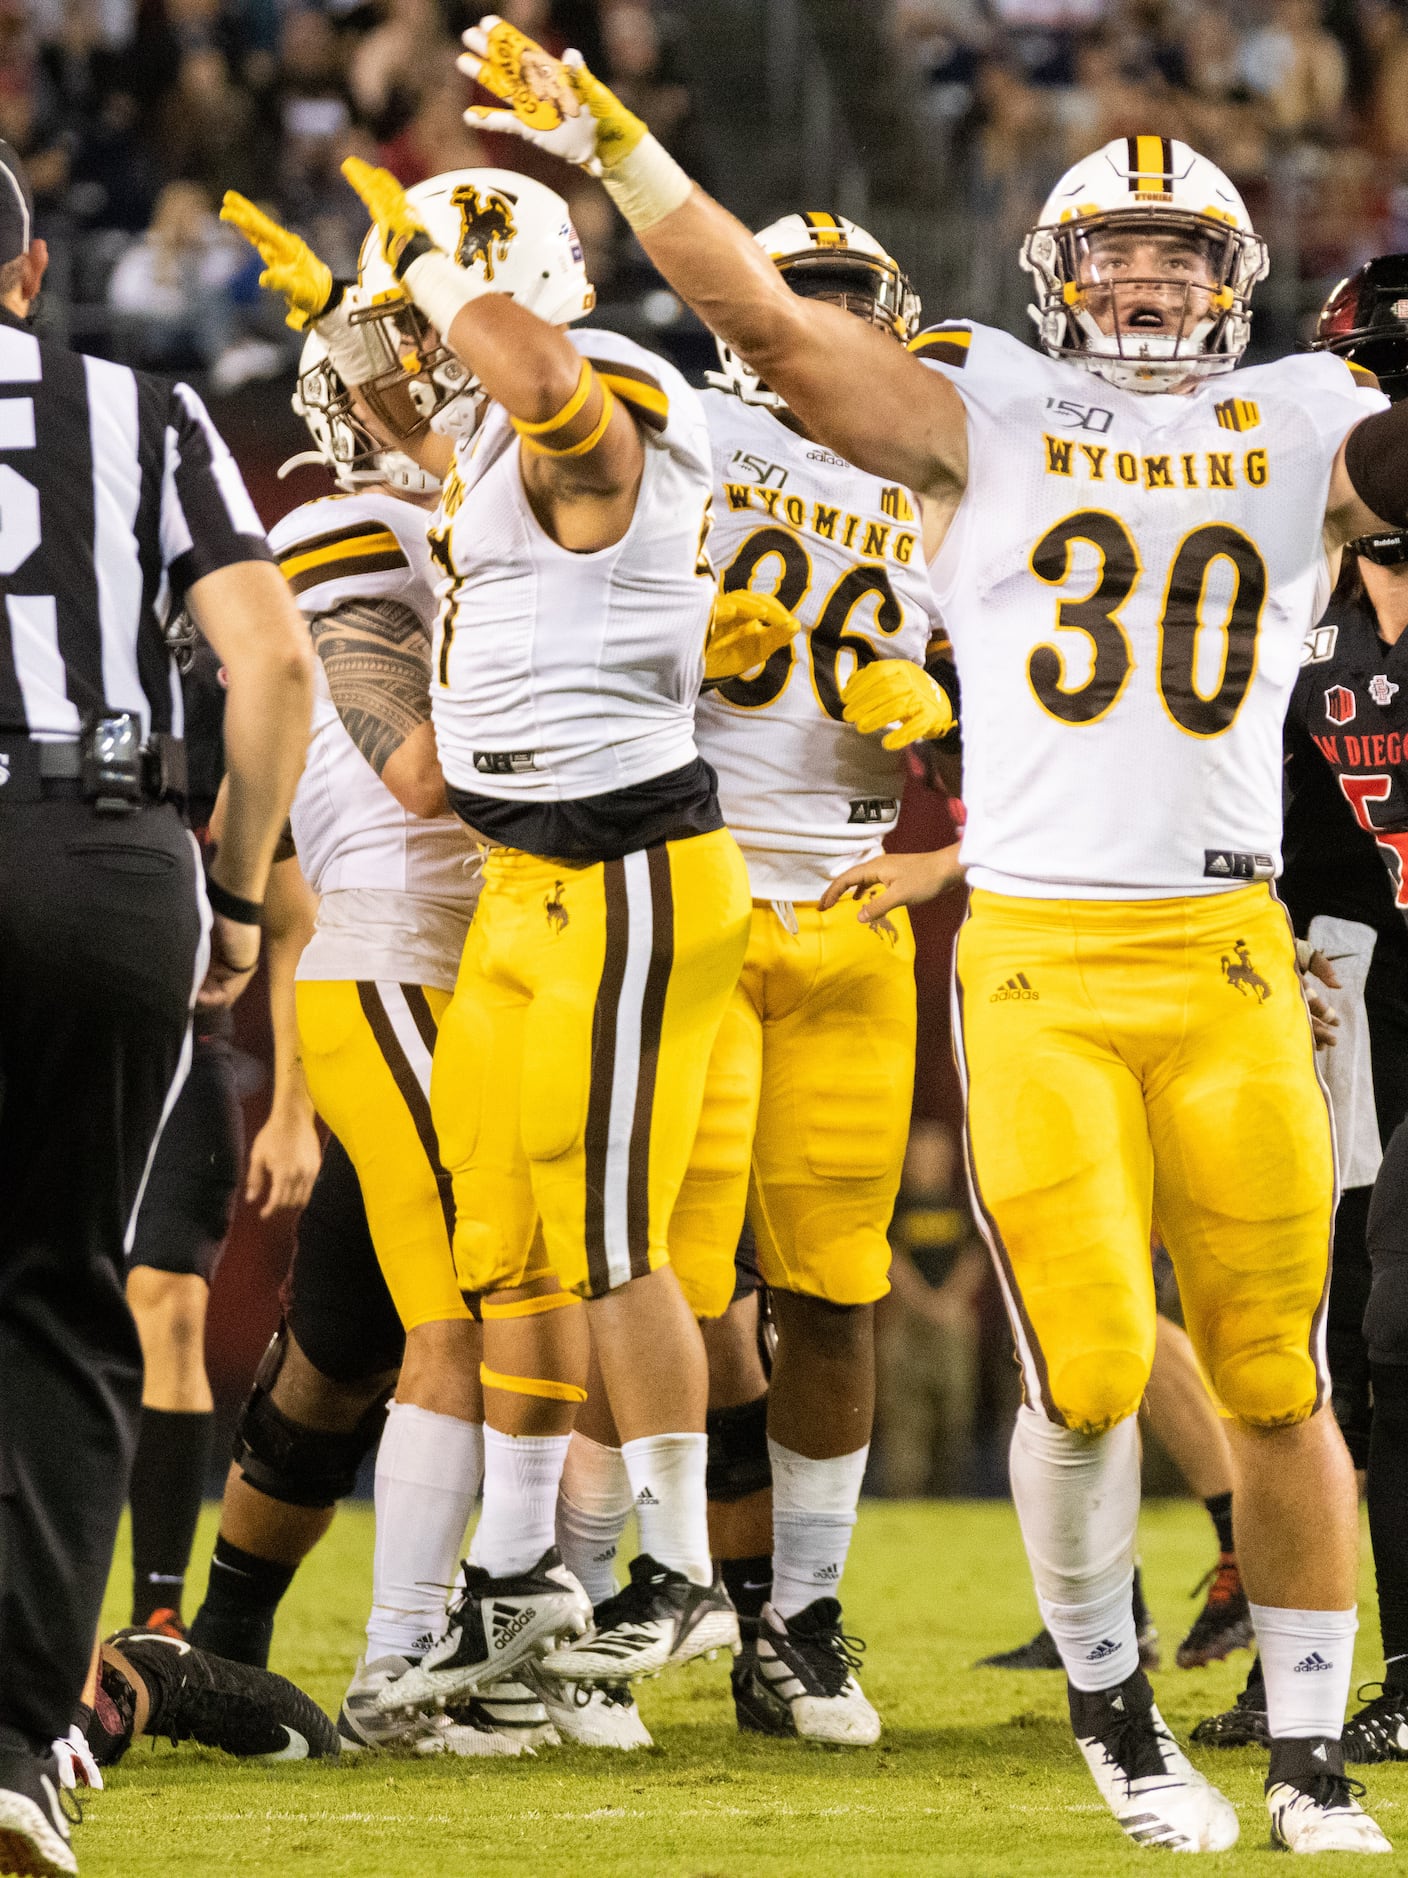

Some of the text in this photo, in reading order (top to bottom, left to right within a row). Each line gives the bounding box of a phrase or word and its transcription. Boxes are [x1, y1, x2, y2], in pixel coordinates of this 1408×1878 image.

[1042, 432, 1269, 490] WYOMING
[723, 483, 916, 565] WYOMING
[1025, 506, 1269, 740] 30
[989, 988, 1040, 1003] adidas
[494, 1605, 537, 1651] adidas
[1293, 1660, 1333, 1673] adidas
